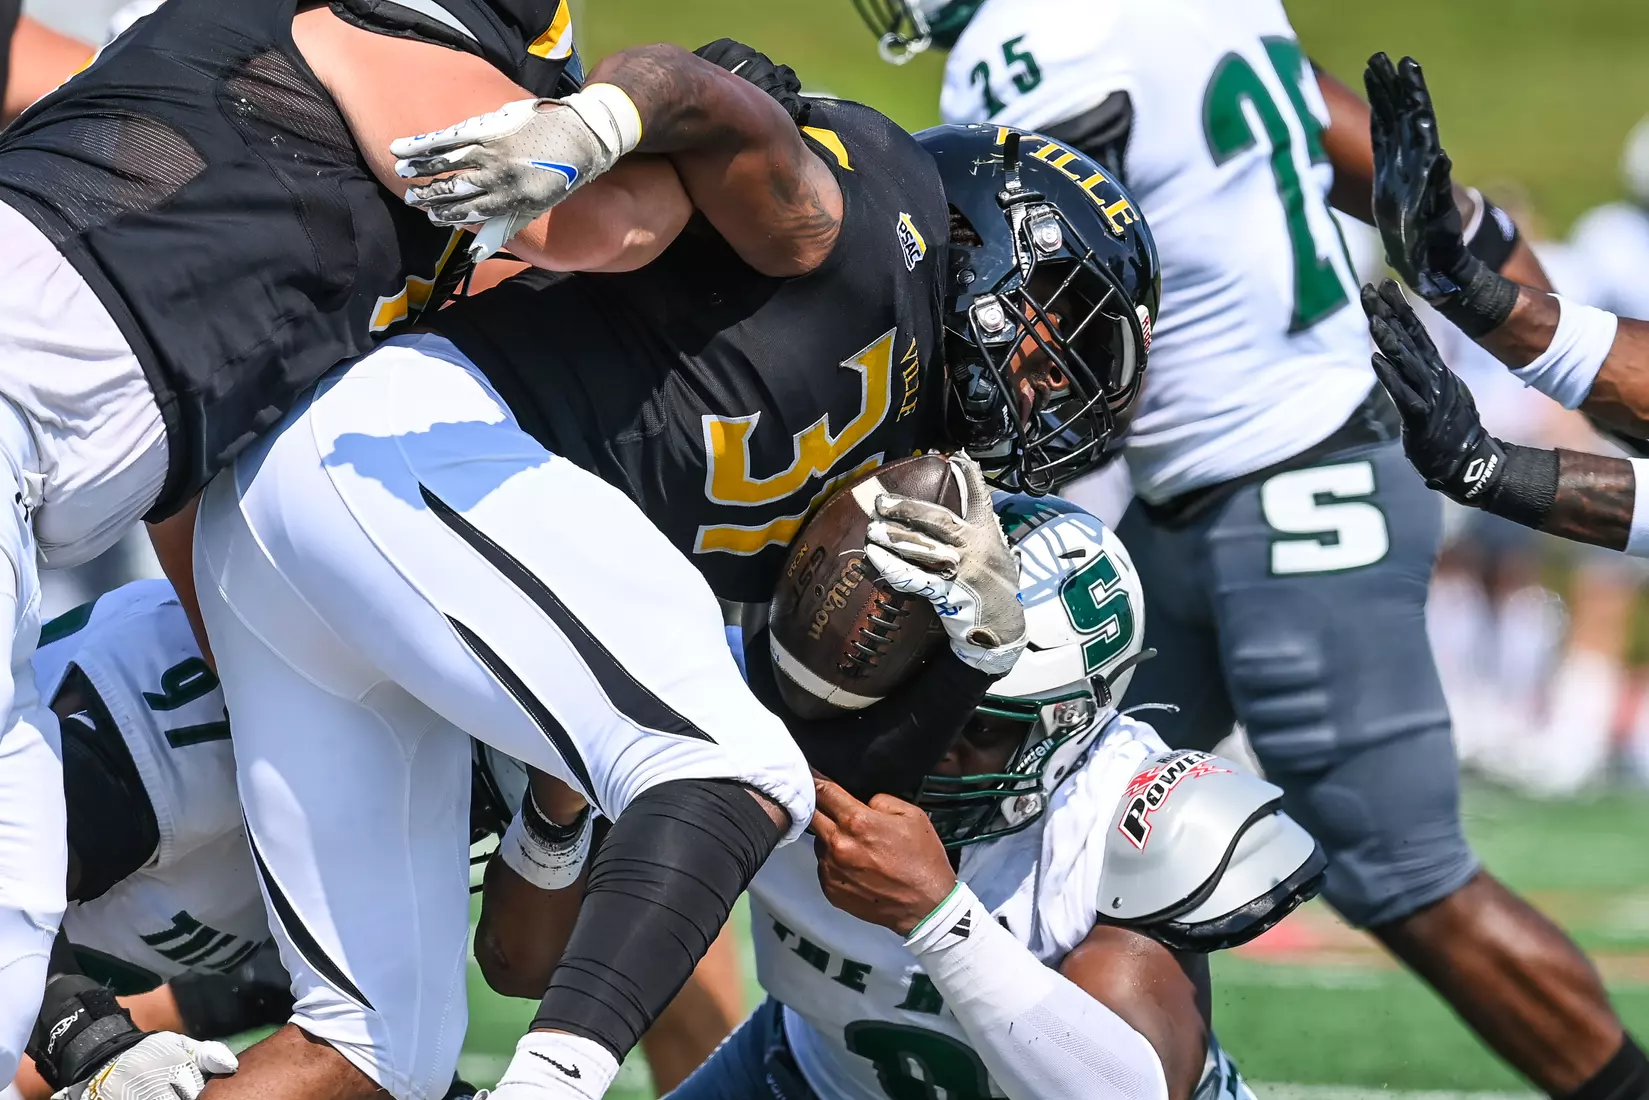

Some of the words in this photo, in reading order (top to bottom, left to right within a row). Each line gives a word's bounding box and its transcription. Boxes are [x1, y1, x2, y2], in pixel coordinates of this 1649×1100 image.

[966, 35, 1044, 121] 25
[898, 220, 921, 264] PSAC
[896, 336, 920, 423] VILLE
[693, 326, 898, 557] 3
[1464, 453, 1499, 499] CUTTERS
[1260, 461, 1390, 578] S
[807, 558, 867, 641] Wilson
[1060, 549, 1135, 675] S
